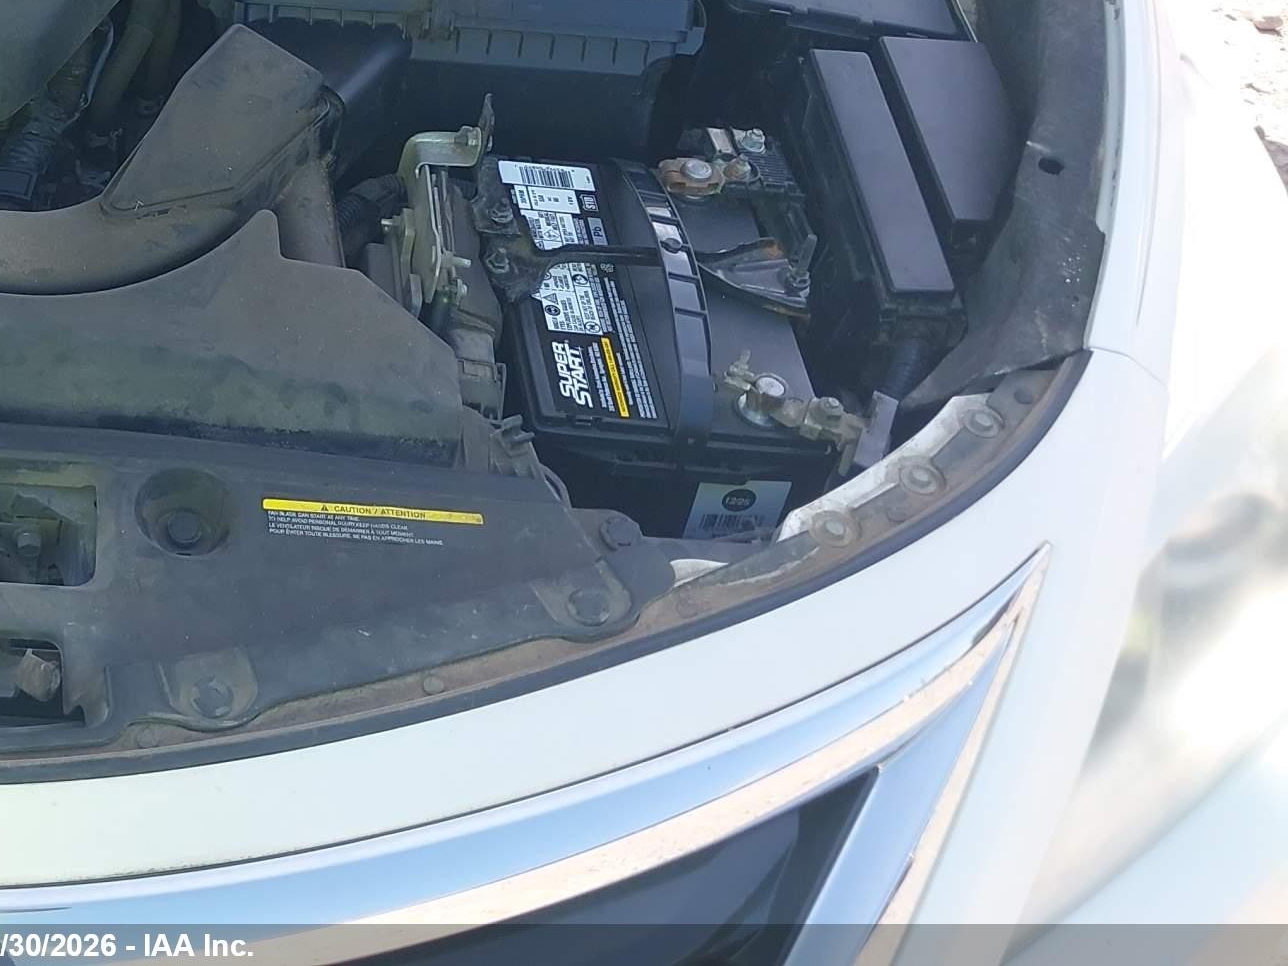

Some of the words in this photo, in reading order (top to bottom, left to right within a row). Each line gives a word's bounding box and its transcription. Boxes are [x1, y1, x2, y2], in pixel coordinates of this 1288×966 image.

[592, 227, 603, 237] Pb
[552, 341, 575, 398] SUPER
[564, 343, 593, 408] START
[334, 505, 372, 515] CAUTION
[381, 508, 426, 519] ATTENTION
